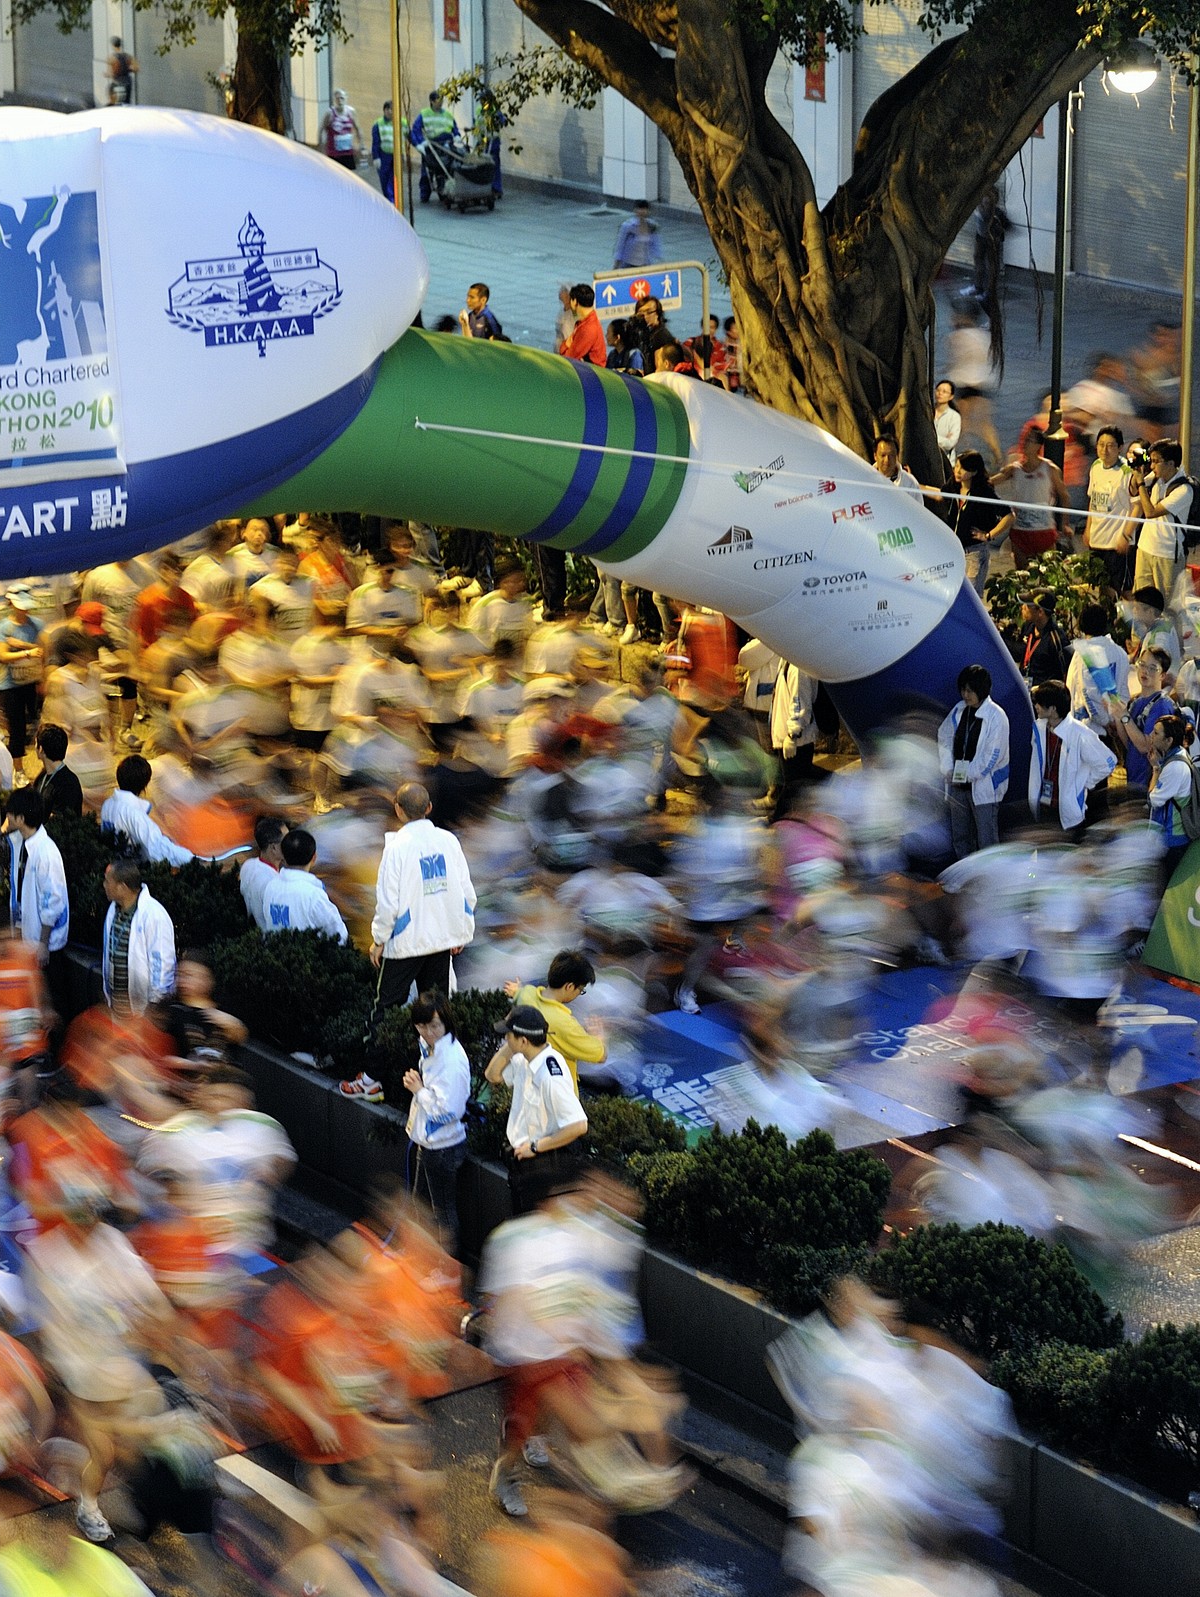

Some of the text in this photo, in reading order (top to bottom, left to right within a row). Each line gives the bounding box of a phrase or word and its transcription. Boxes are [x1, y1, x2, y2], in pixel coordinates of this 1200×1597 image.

[214, 318, 305, 344] H.K.A.A.A.
[24, 359, 110, 387] Chartered
[58, 395, 114, 431] 2010
[90, 485, 128, 531] 點
[788, 491, 814, 504] balance
[831, 501, 873, 524] PURE
[877, 526, 914, 551] POAD
[753, 549, 814, 571] CITIZEN
[822, 571, 867, 586] TOYOTA
